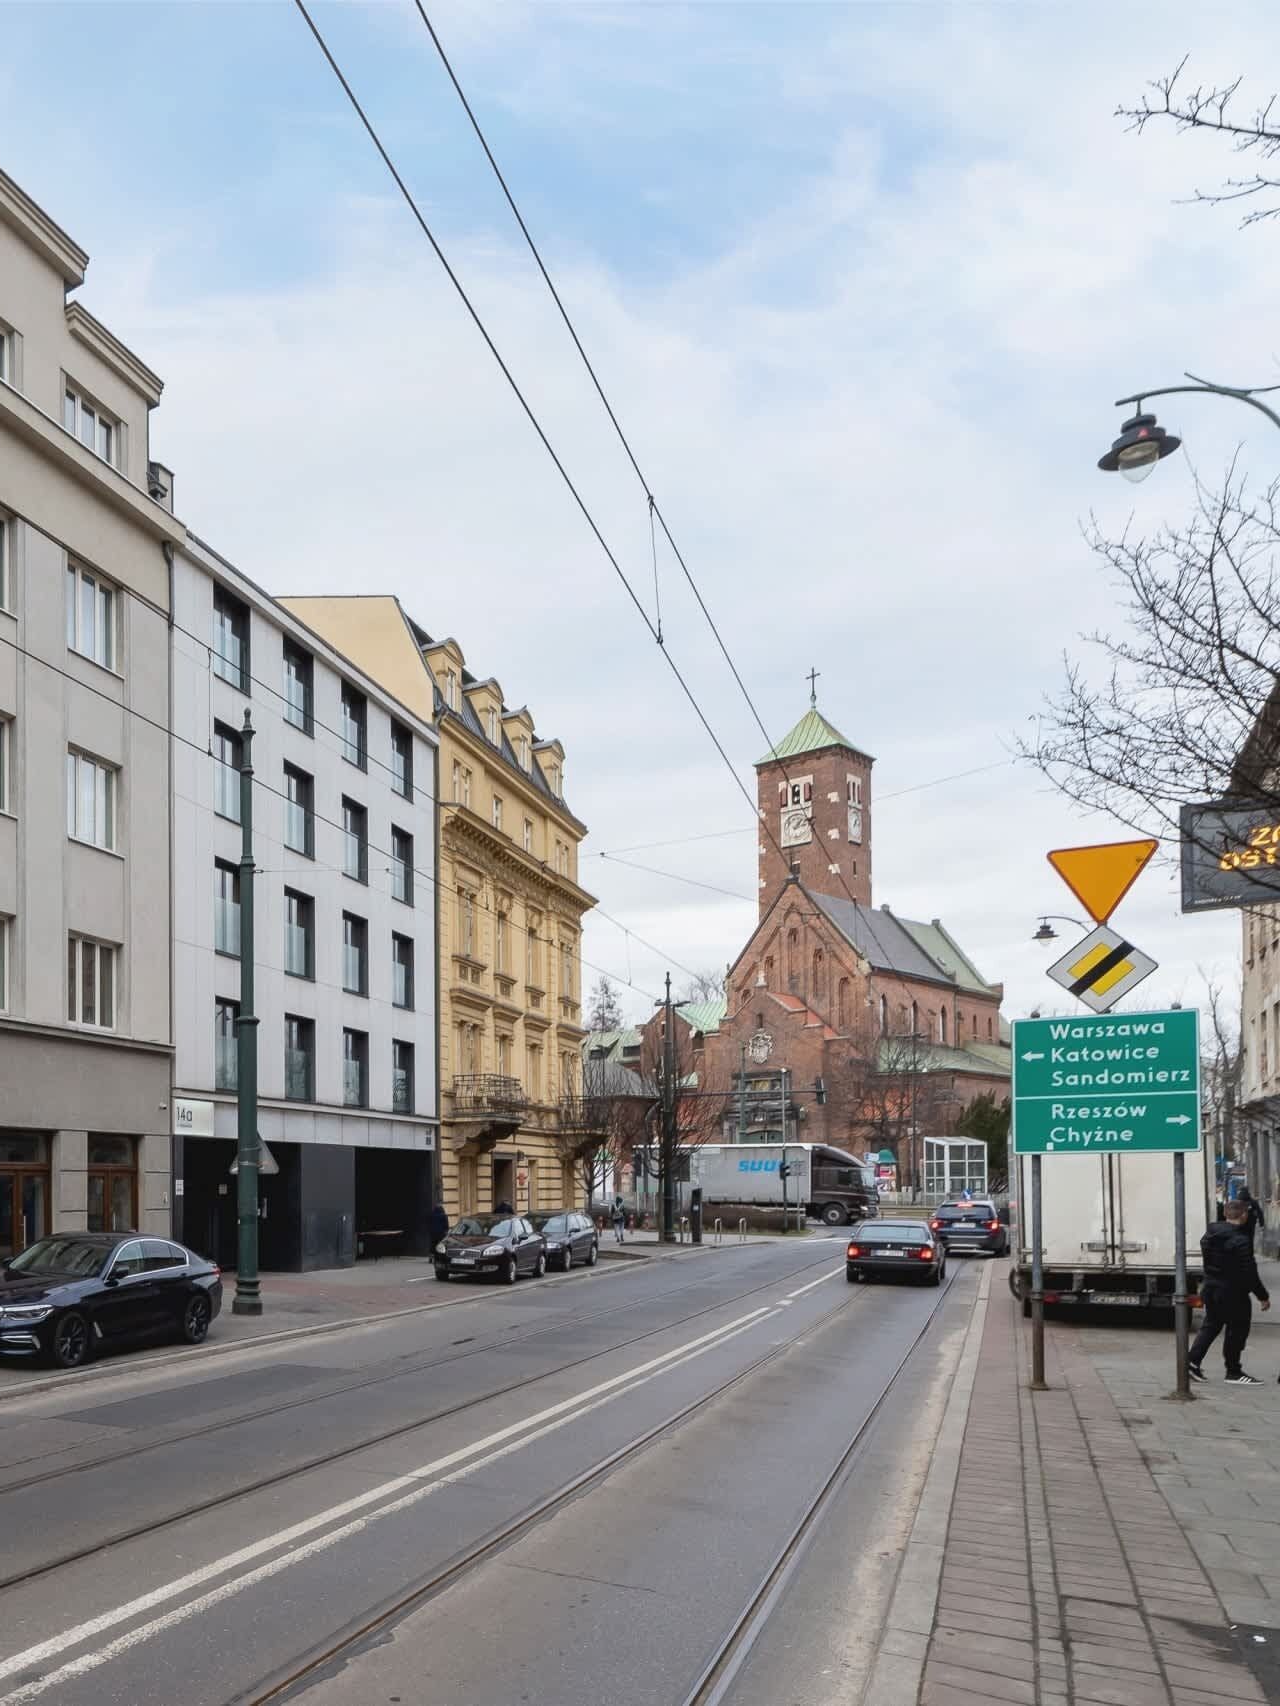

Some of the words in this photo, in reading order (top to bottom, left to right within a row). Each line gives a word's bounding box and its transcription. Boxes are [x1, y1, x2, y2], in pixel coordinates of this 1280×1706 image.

[1050, 1022, 1165, 1040] Warszawa
[1051, 1044, 1160, 1063] Katowice
[1051, 1067, 1190, 1087] Sandomierz
[1052, 1101, 1147, 1120] Rzeszów
